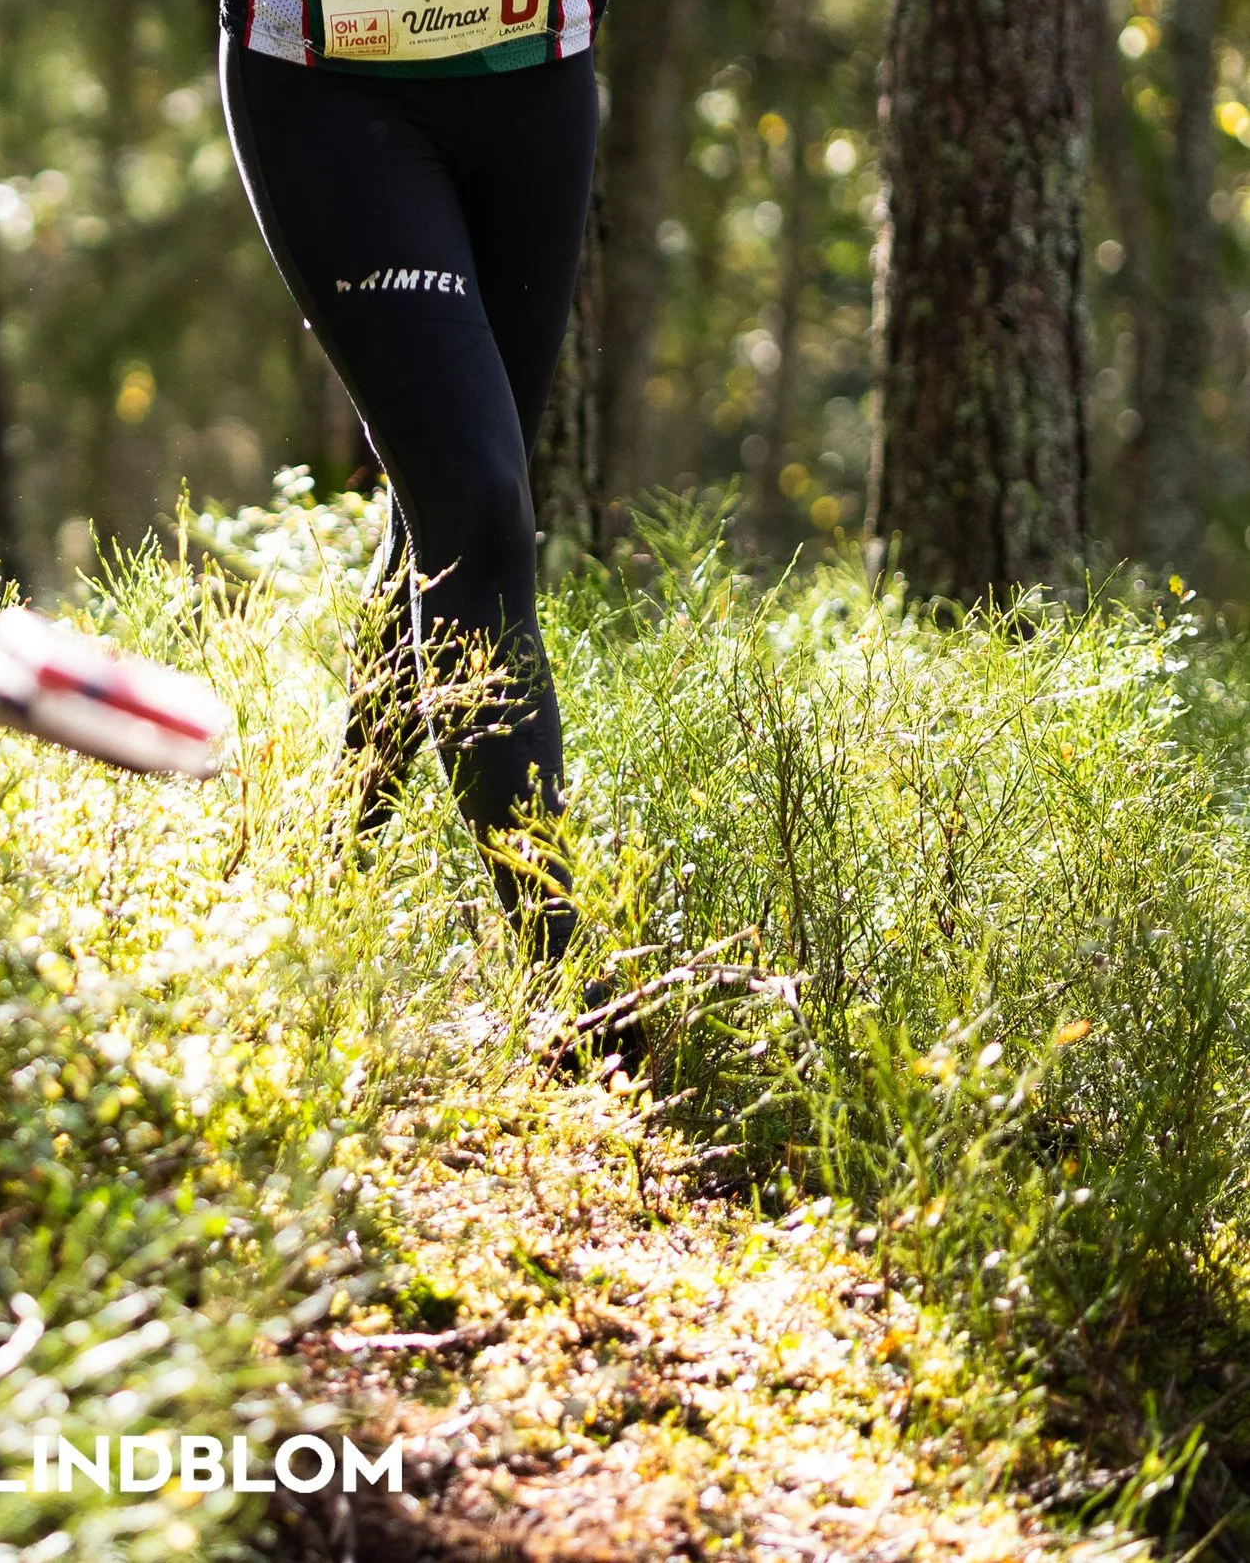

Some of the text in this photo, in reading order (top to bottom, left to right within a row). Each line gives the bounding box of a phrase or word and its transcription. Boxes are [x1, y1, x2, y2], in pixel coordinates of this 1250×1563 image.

[401, 6, 490, 35] Ullmax
[498, 21, 536, 37] UMARA
[335, 34, 387, 47] Tisaren
